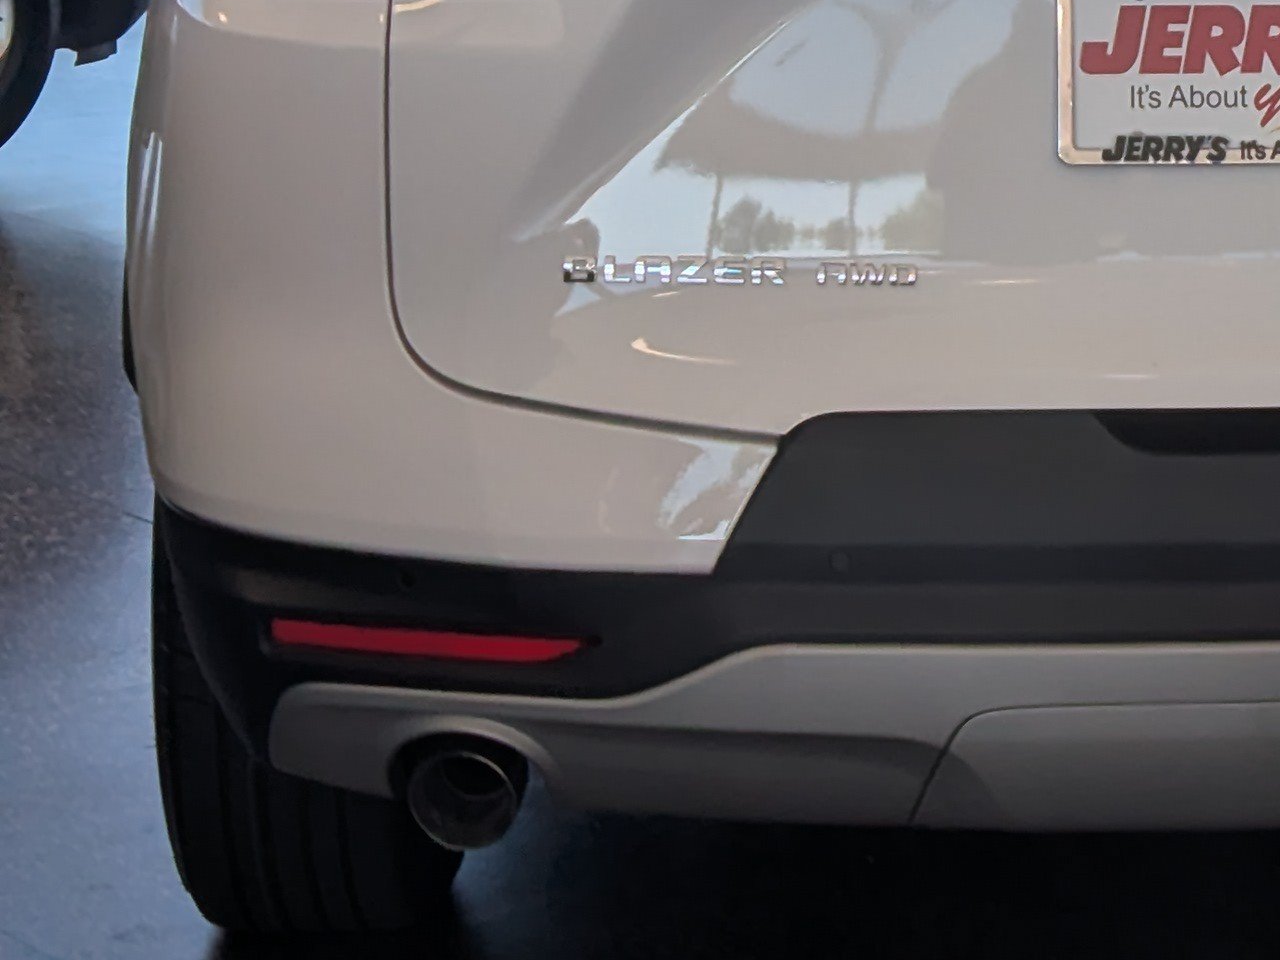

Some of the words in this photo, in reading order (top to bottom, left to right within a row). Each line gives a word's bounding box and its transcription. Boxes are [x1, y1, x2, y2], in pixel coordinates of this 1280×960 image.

[1130, 85, 1162, 109] It's
[1168, 85, 1248, 109] About
[1102, 135, 1229, 162] JERRY'S
[1240, 141, 1267, 160] It's
[563, 255, 785, 283] BLAZER
[816, 262, 917, 285] AWD
